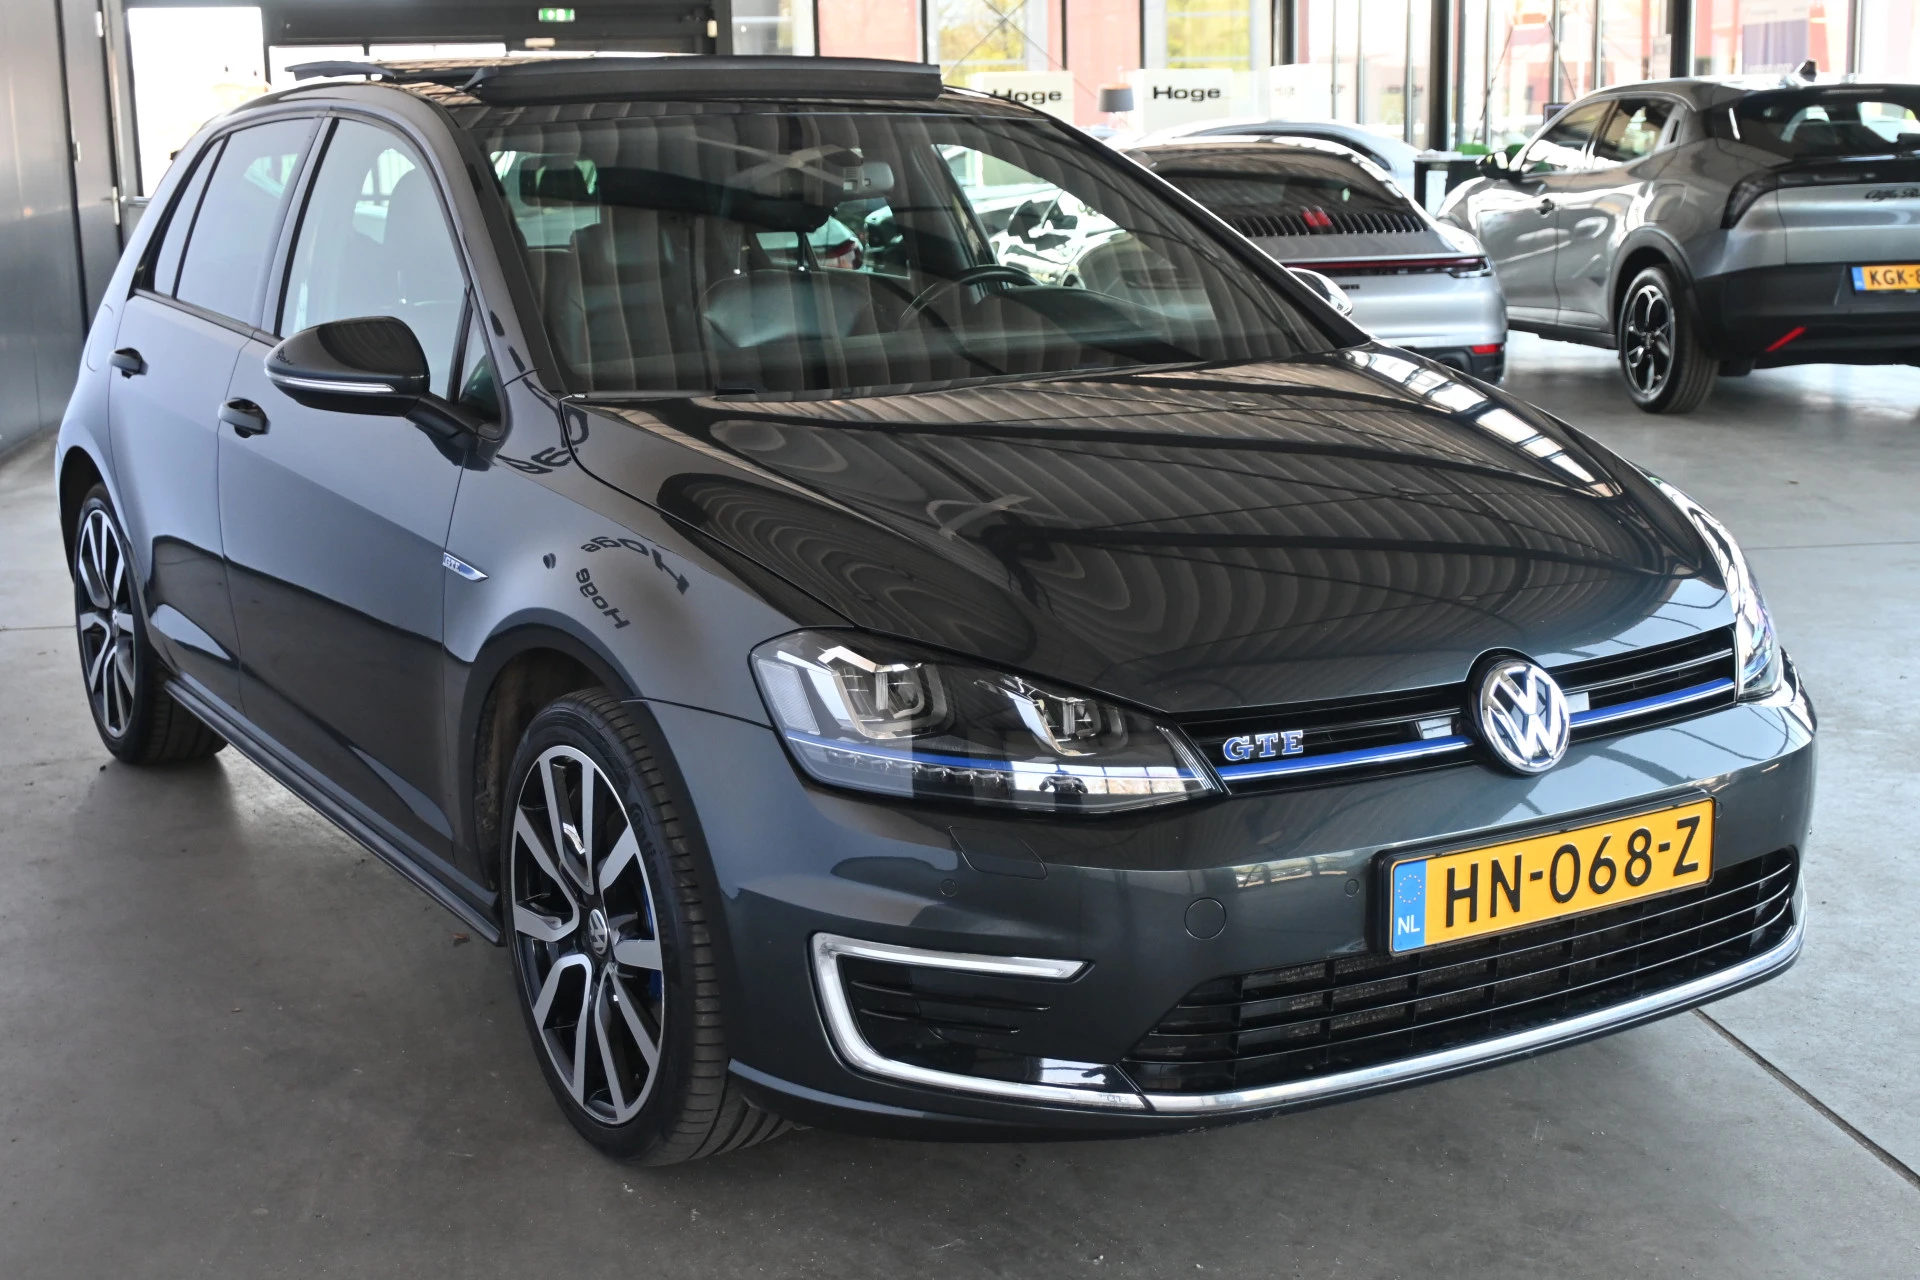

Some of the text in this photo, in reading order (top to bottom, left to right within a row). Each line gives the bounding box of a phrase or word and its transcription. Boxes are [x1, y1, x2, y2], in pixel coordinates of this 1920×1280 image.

[993, 88, 1063, 104] Hoge
[1152, 86, 1222, 102] Hoge
[1223, 729, 1304, 761] GTE
[1446, 815, 1701, 928] HN-068-Z
[1397, 915, 1421, 936] NL
